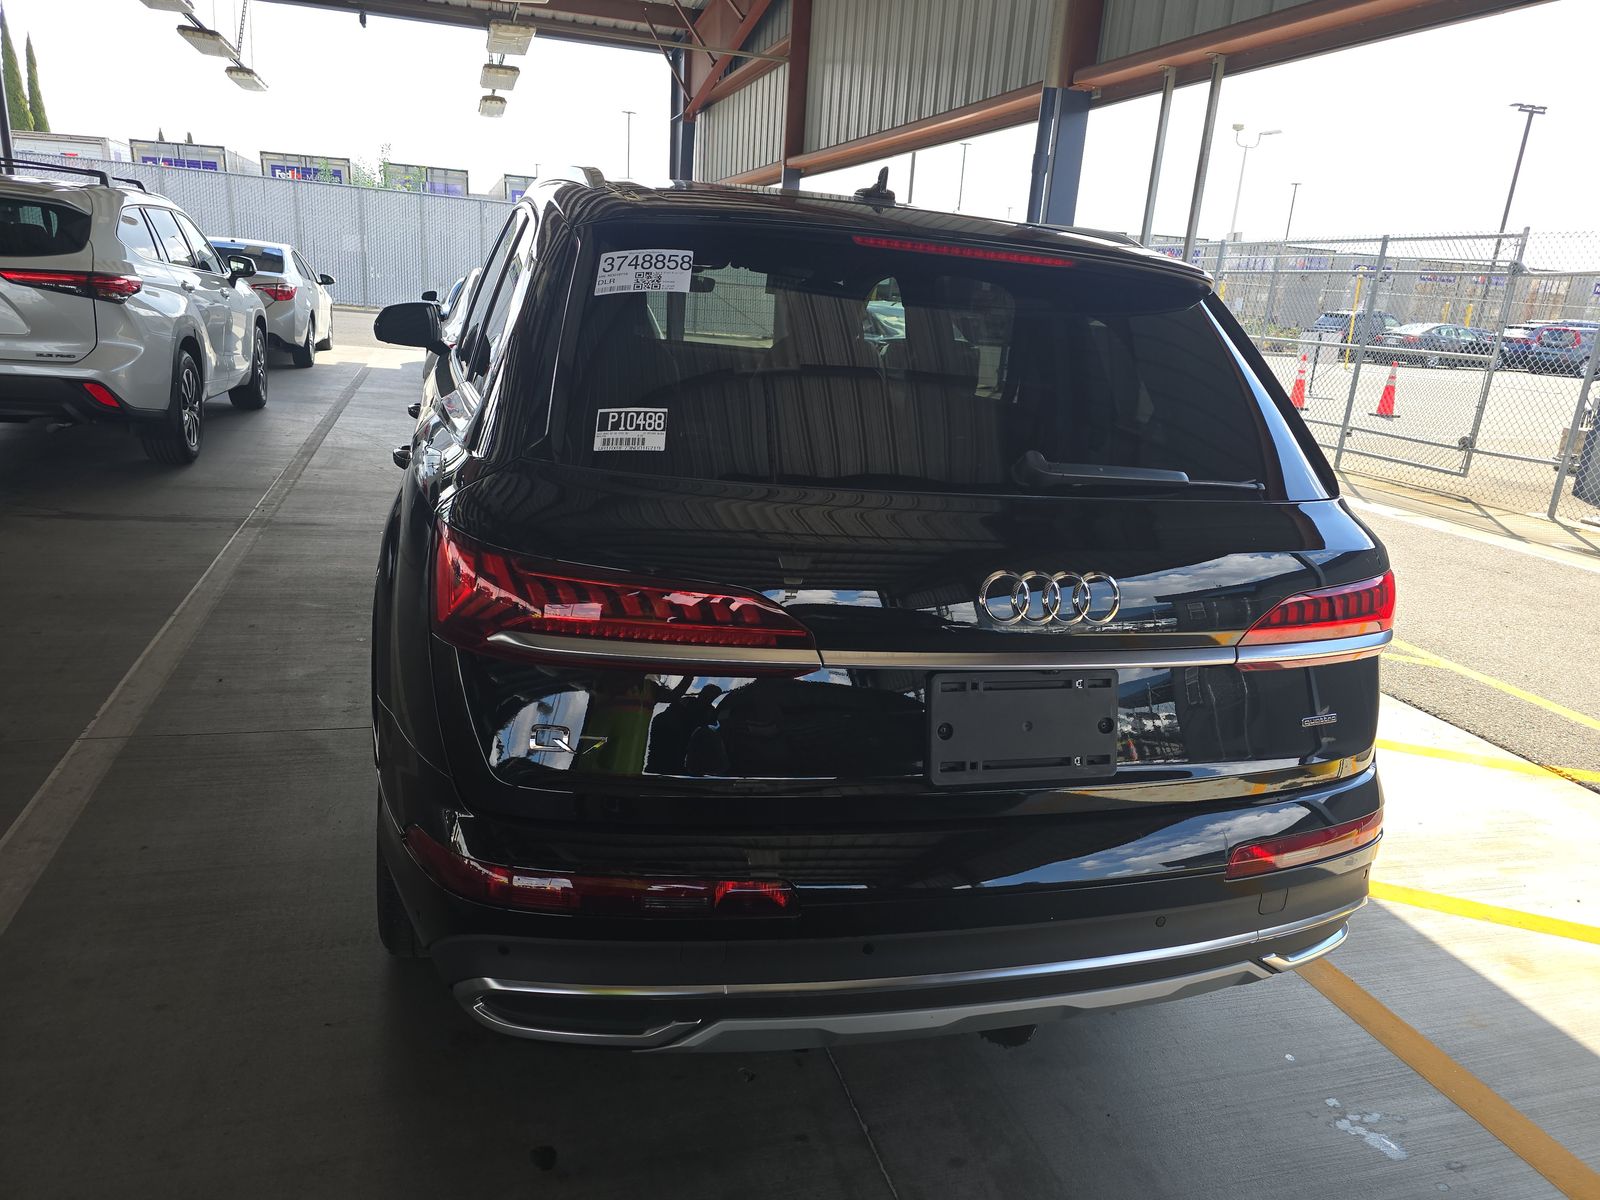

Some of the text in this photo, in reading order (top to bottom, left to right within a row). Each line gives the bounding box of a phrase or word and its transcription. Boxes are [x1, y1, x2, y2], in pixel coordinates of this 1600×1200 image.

[602, 253, 692, 273] 3748858
[597, 278, 616, 286] DLR
[607, 412, 665, 431] P10488
